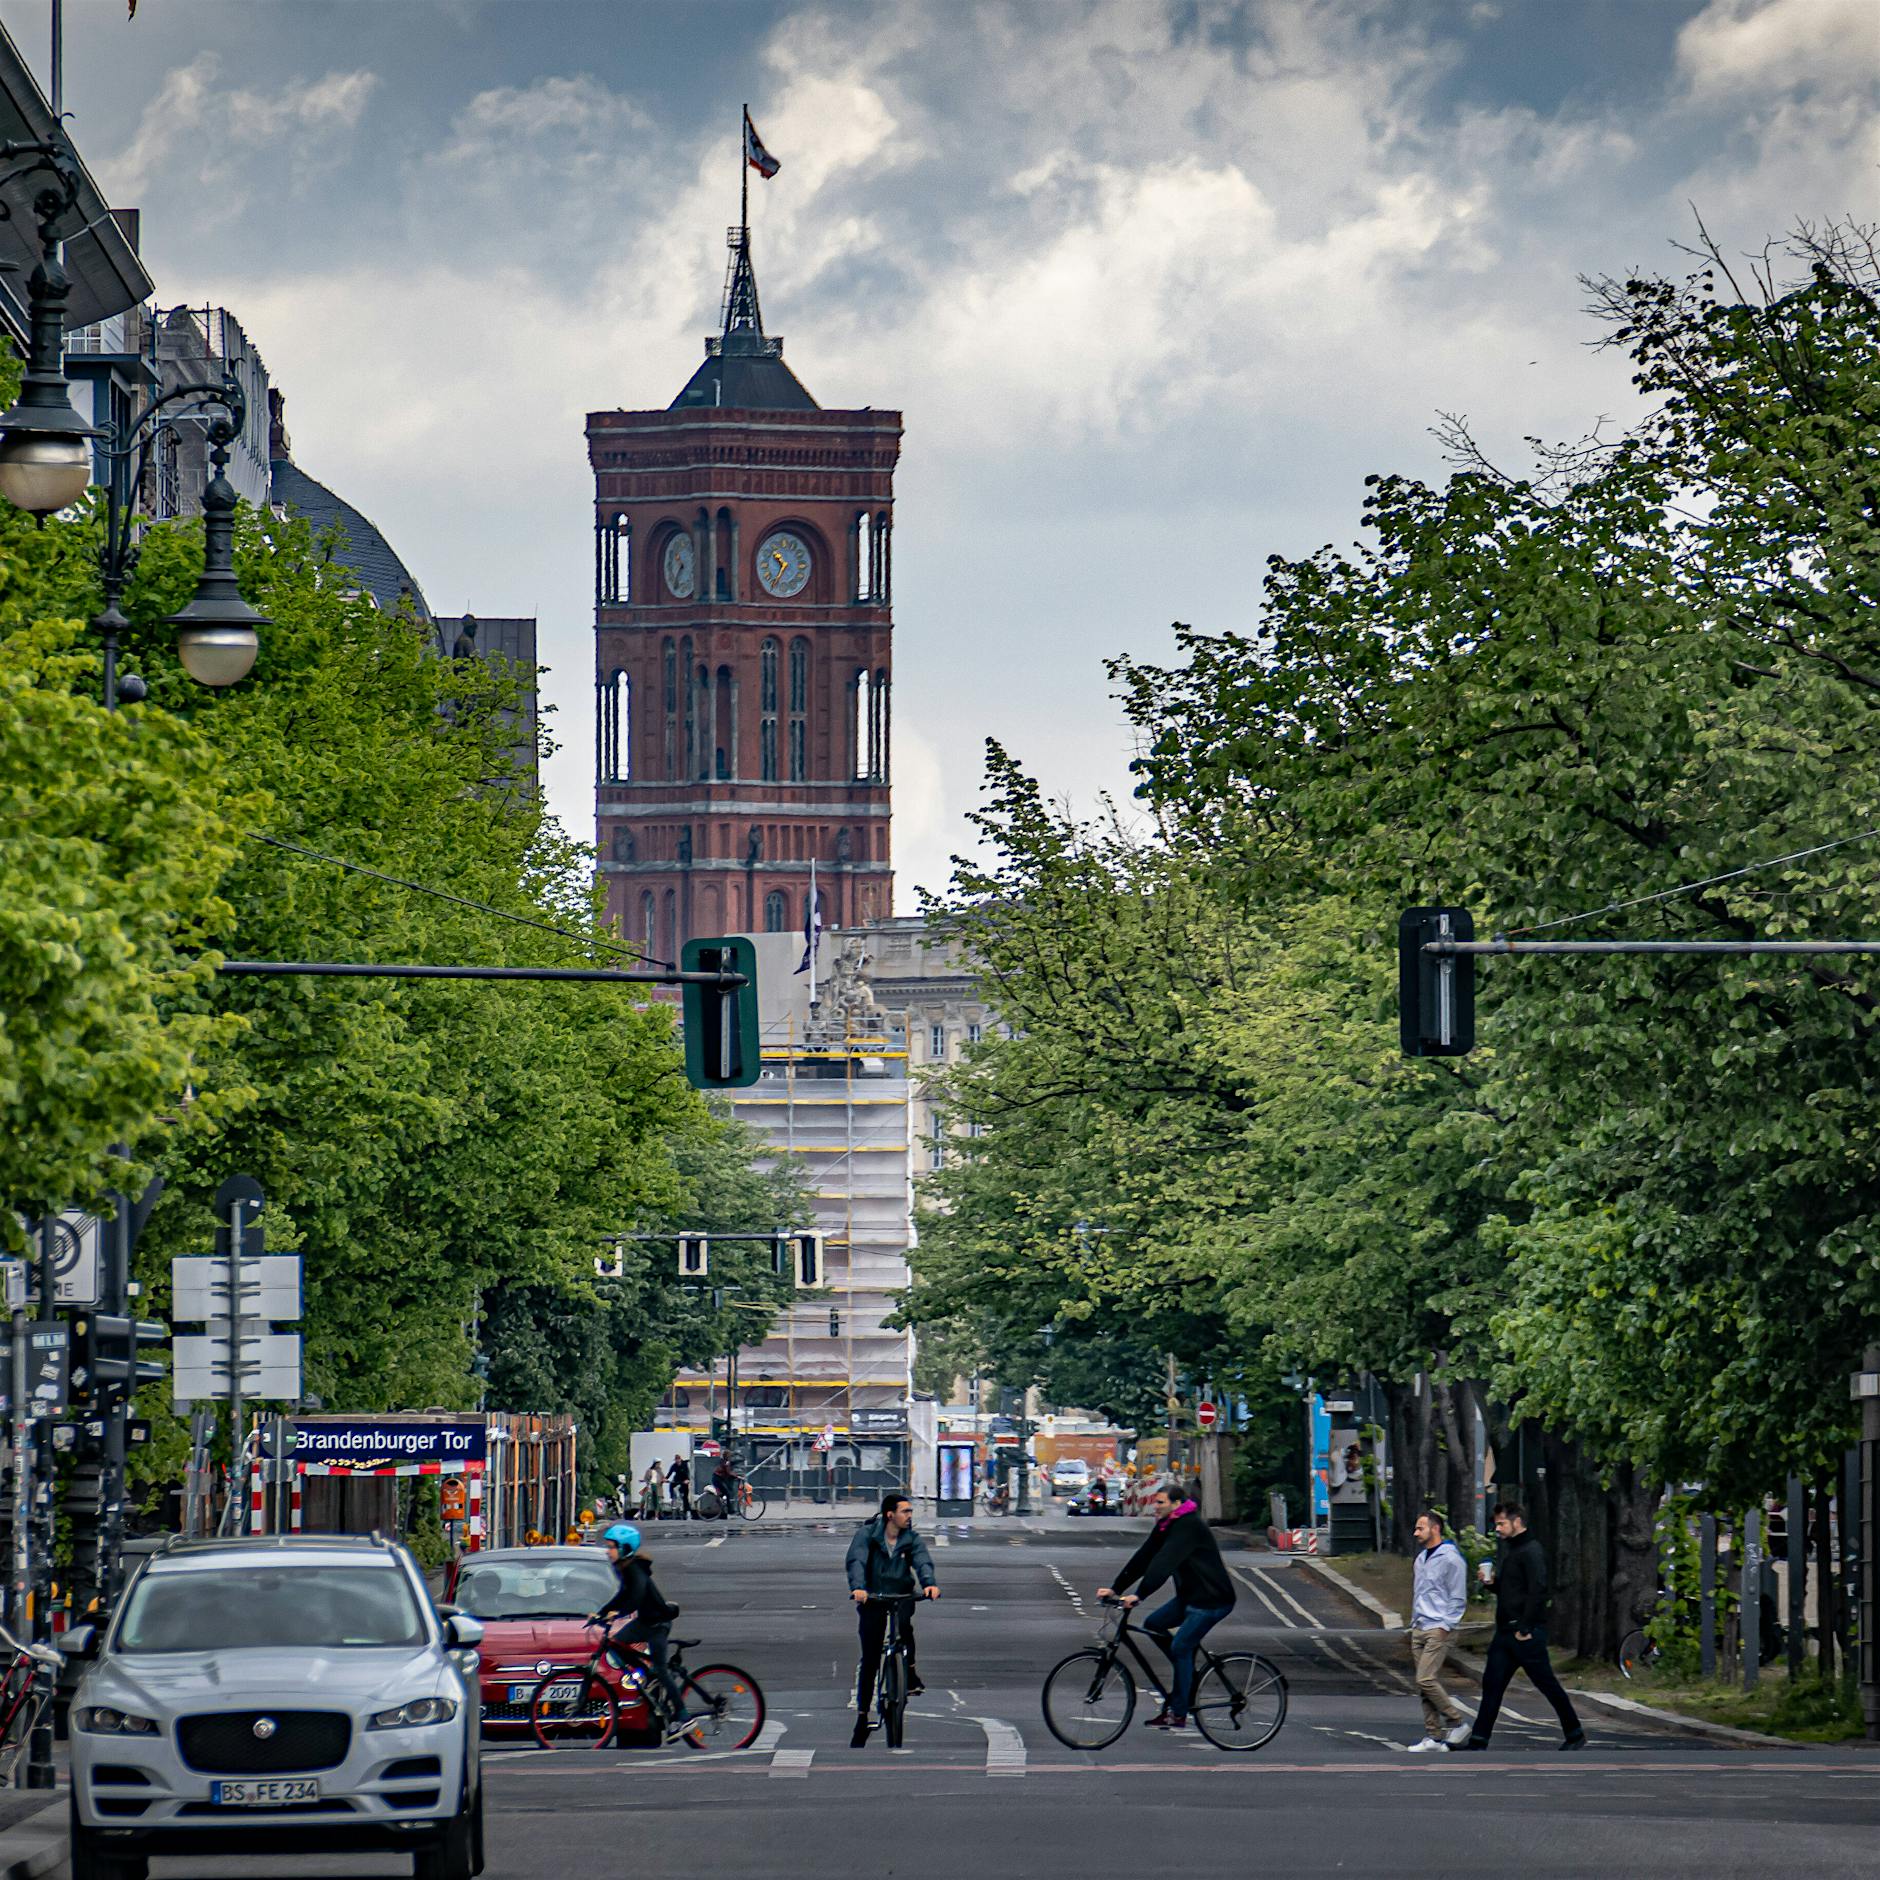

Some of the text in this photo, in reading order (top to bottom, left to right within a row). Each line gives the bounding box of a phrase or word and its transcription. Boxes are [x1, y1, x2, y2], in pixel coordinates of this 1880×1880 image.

[296, 1430, 473, 1453] Brandenburger Tor
[222, 1781, 316, 1802] BS FE 234
